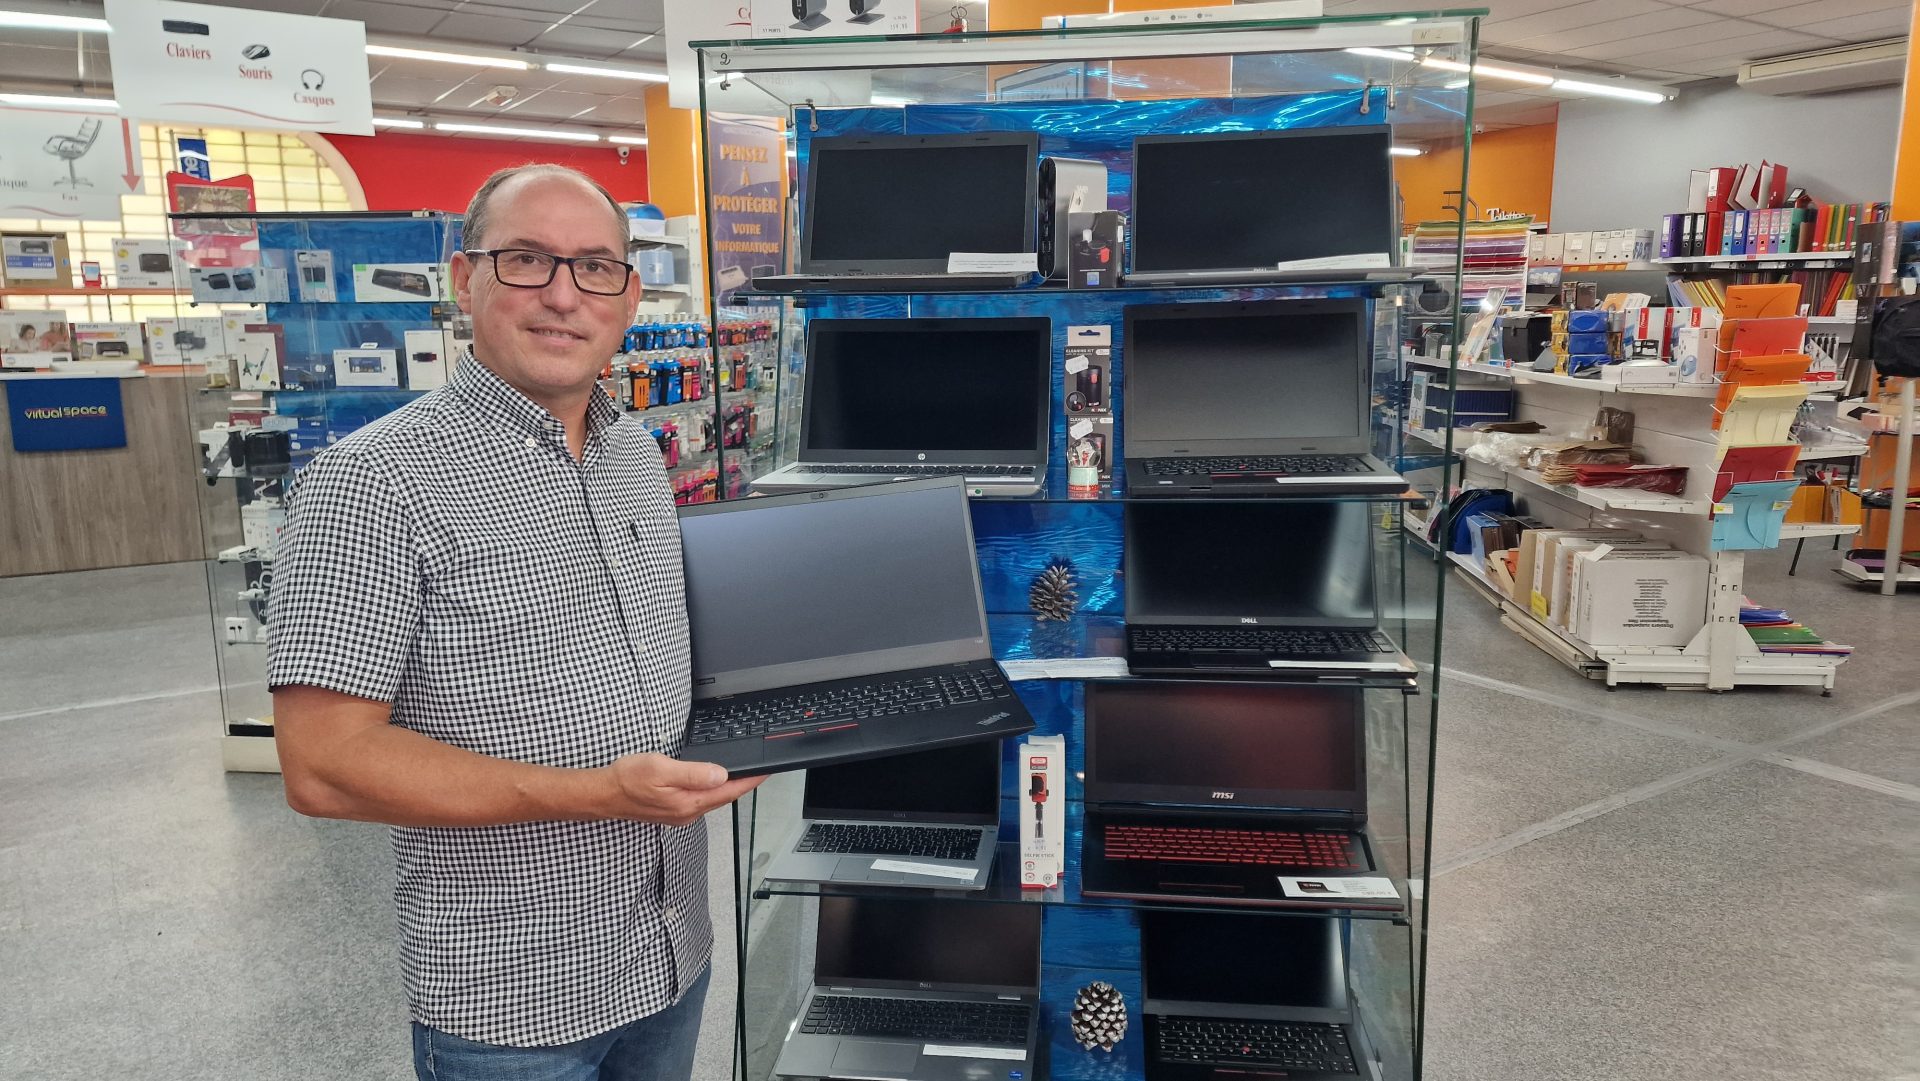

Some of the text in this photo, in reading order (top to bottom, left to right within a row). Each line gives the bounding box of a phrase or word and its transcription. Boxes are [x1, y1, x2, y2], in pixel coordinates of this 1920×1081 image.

[166, 42, 212, 60] Claviers
[238, 64, 273, 80] Souris
[293, 92, 335, 107] Casques
[719, 144, 768, 163] PENSEZ
[713, 193, 778, 213] PROTÉGER
[732, 223, 762, 235] VOTRE
[715, 241, 780, 254] INFORMATIQUE
[24, 405, 107, 419] virtual space
[1212, 791, 1235, 800] msi
